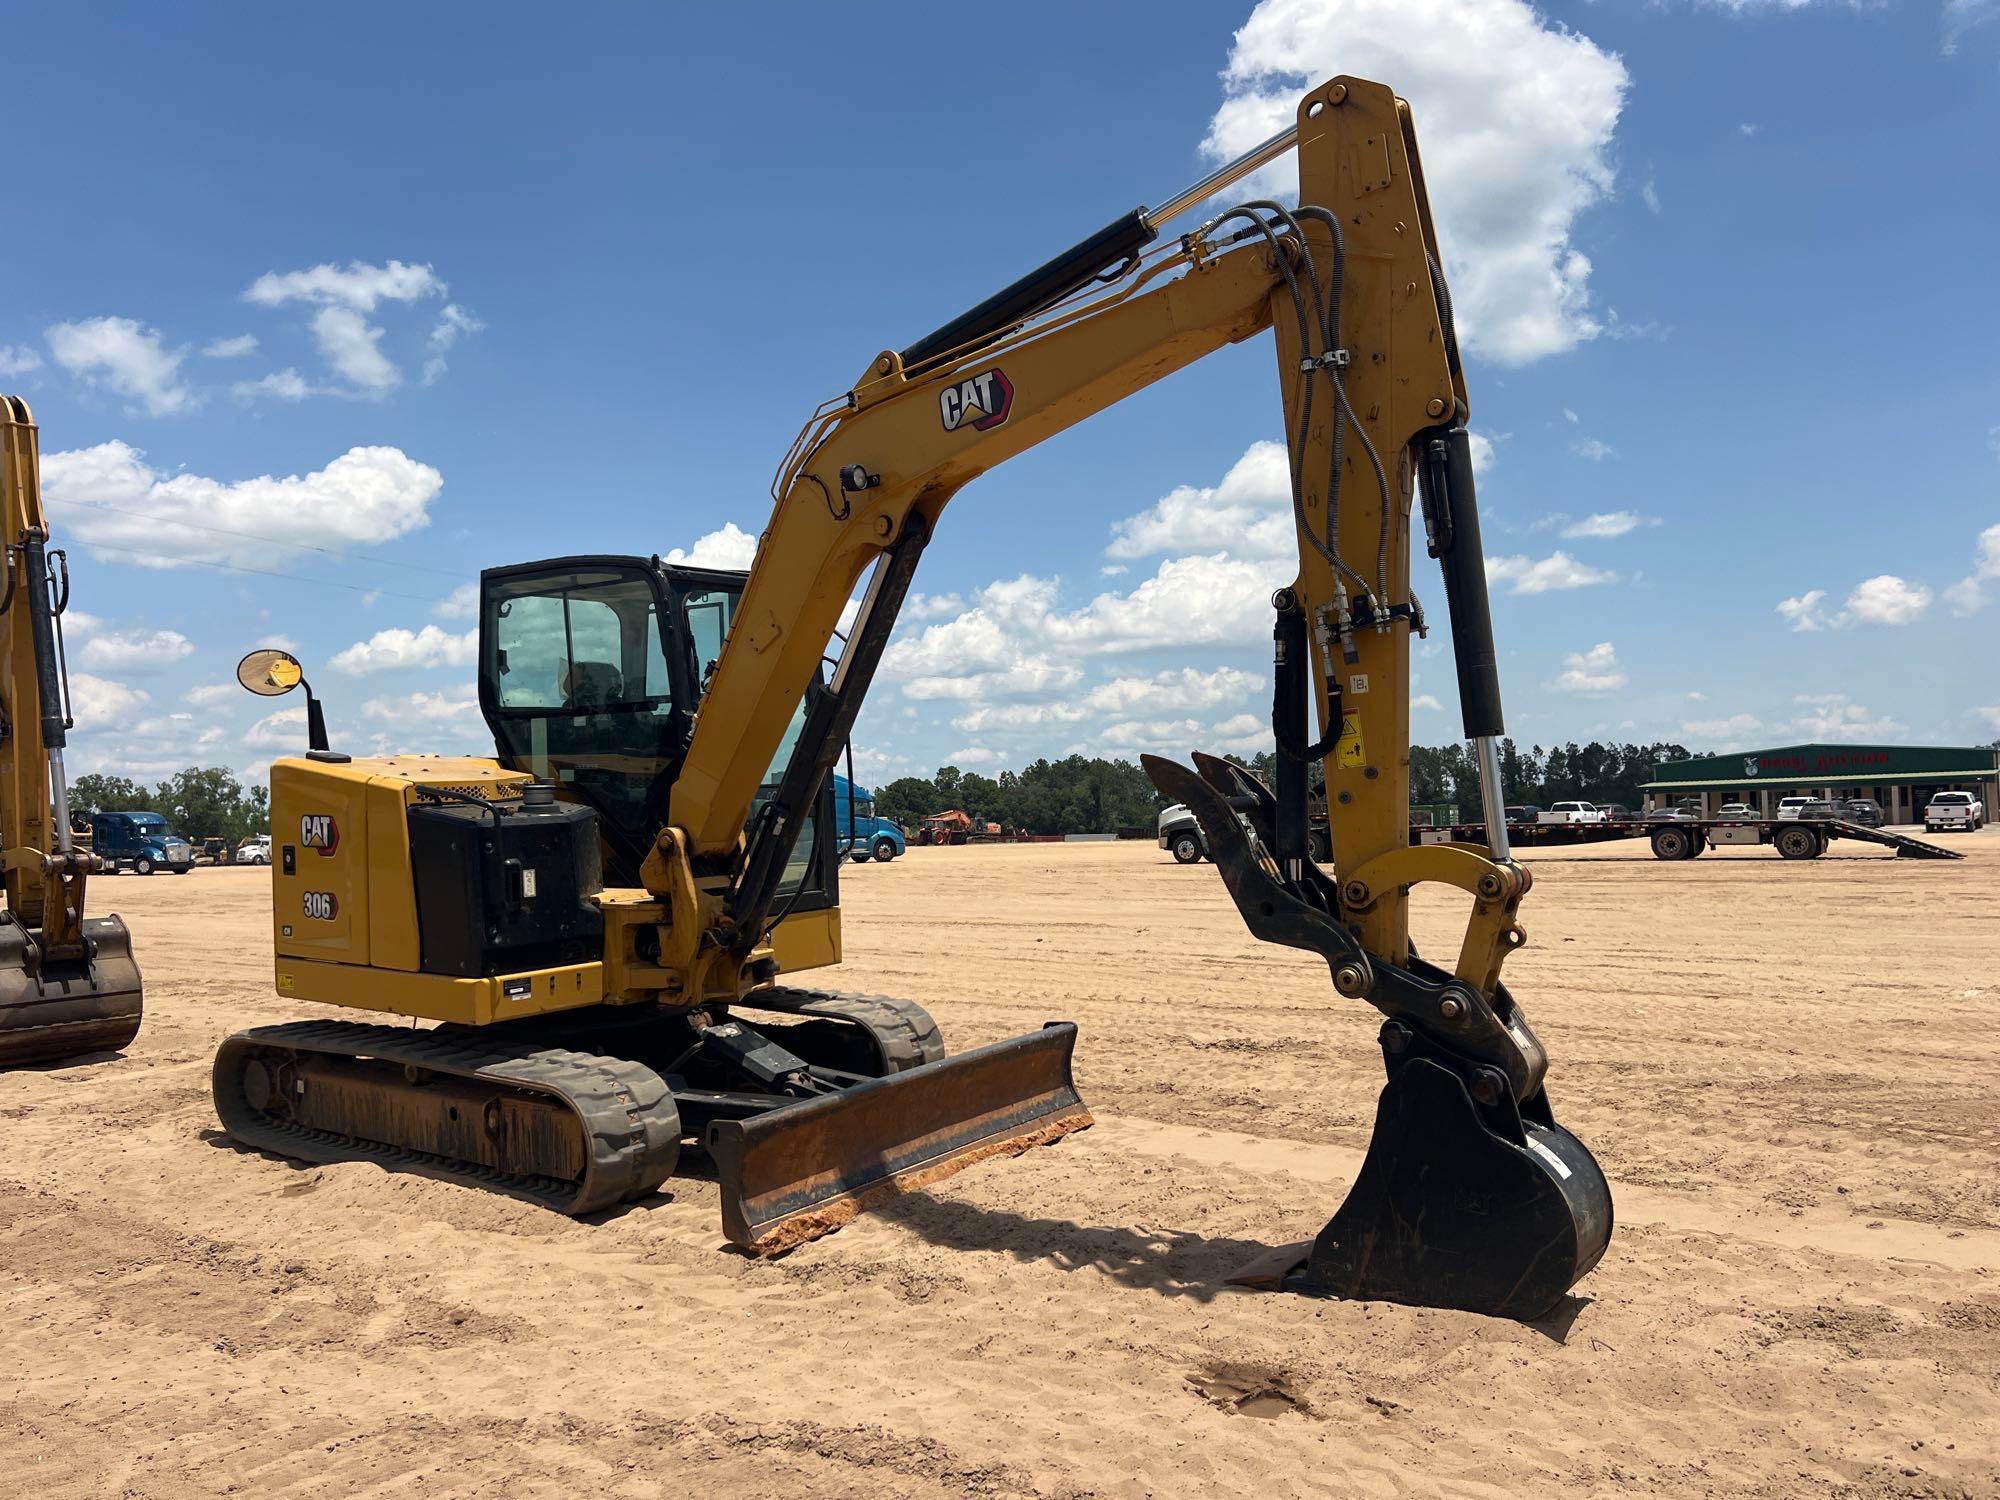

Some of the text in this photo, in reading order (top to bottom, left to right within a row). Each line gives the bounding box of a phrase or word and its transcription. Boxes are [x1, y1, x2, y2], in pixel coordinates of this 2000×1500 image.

[940, 371, 994, 430] CAT
[301, 815, 331, 848] CAT
[303, 892, 331, 919] 306
